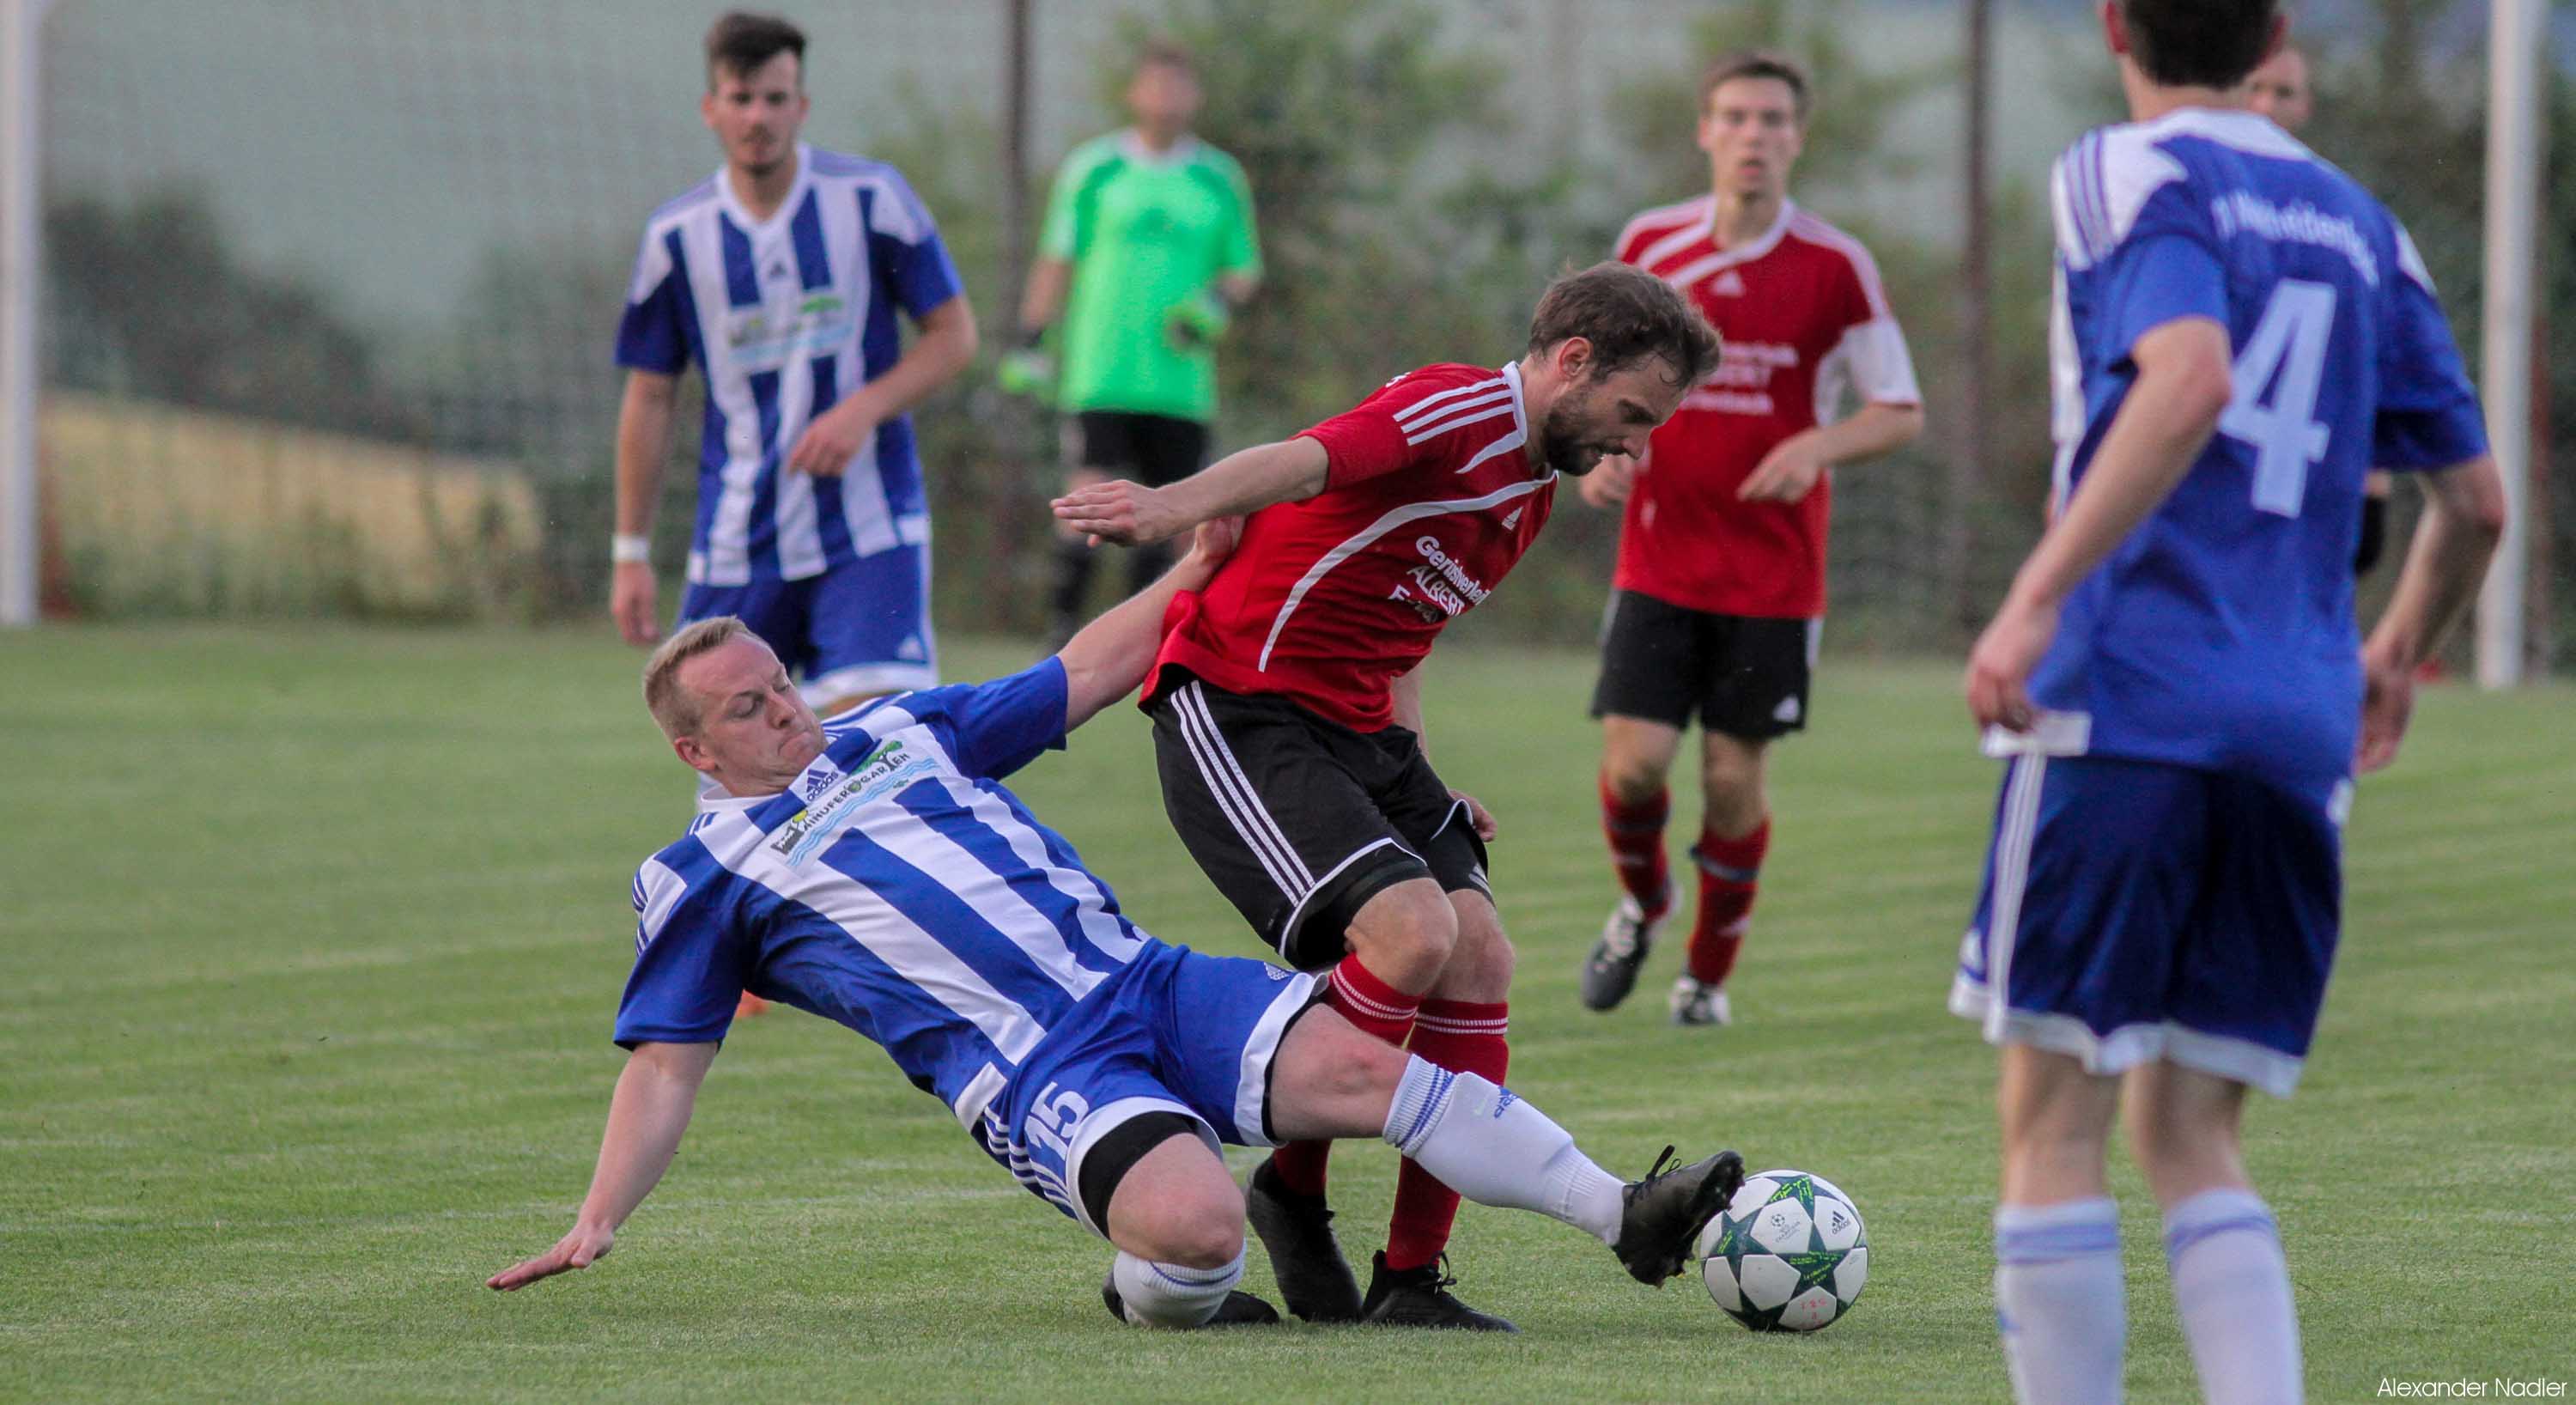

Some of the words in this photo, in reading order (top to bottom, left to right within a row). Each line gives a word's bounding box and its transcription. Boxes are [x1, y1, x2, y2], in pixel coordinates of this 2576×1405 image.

[2218, 277, 2337, 519] 4
[1406, 564, 1466, 617] ALBERT
[806, 769, 841, 802] adidas
[1024, 1081, 1089, 1161] 15
